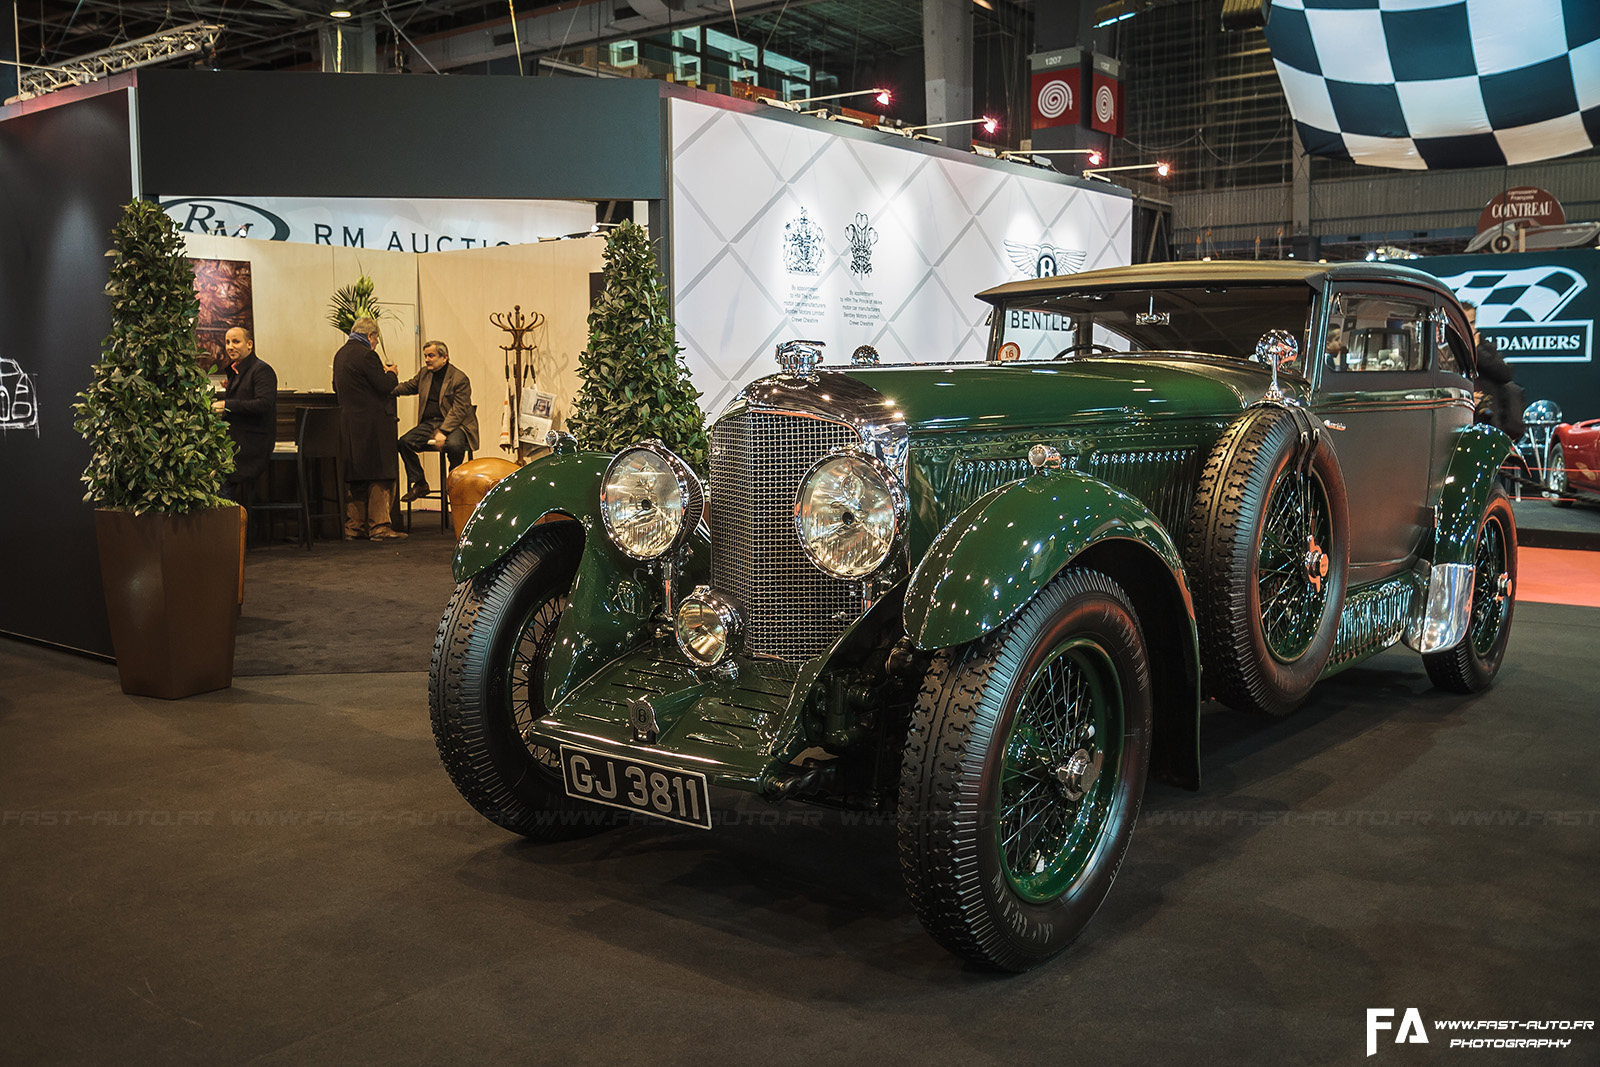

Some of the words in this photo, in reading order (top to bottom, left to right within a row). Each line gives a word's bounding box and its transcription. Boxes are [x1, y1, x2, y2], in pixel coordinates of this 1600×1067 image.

[1045, 55, 1062, 66] 1207
[1491, 200, 1553, 219] COINTREAU
[314, 223, 365, 249] RM
[1011, 310, 1070, 331] BENTLE
[1495, 334, 1581, 351] DAMIERS
[1005, 349, 1015, 360] 16
[570, 754, 617, 799] GJ
[625, 766, 700, 820] 3811
